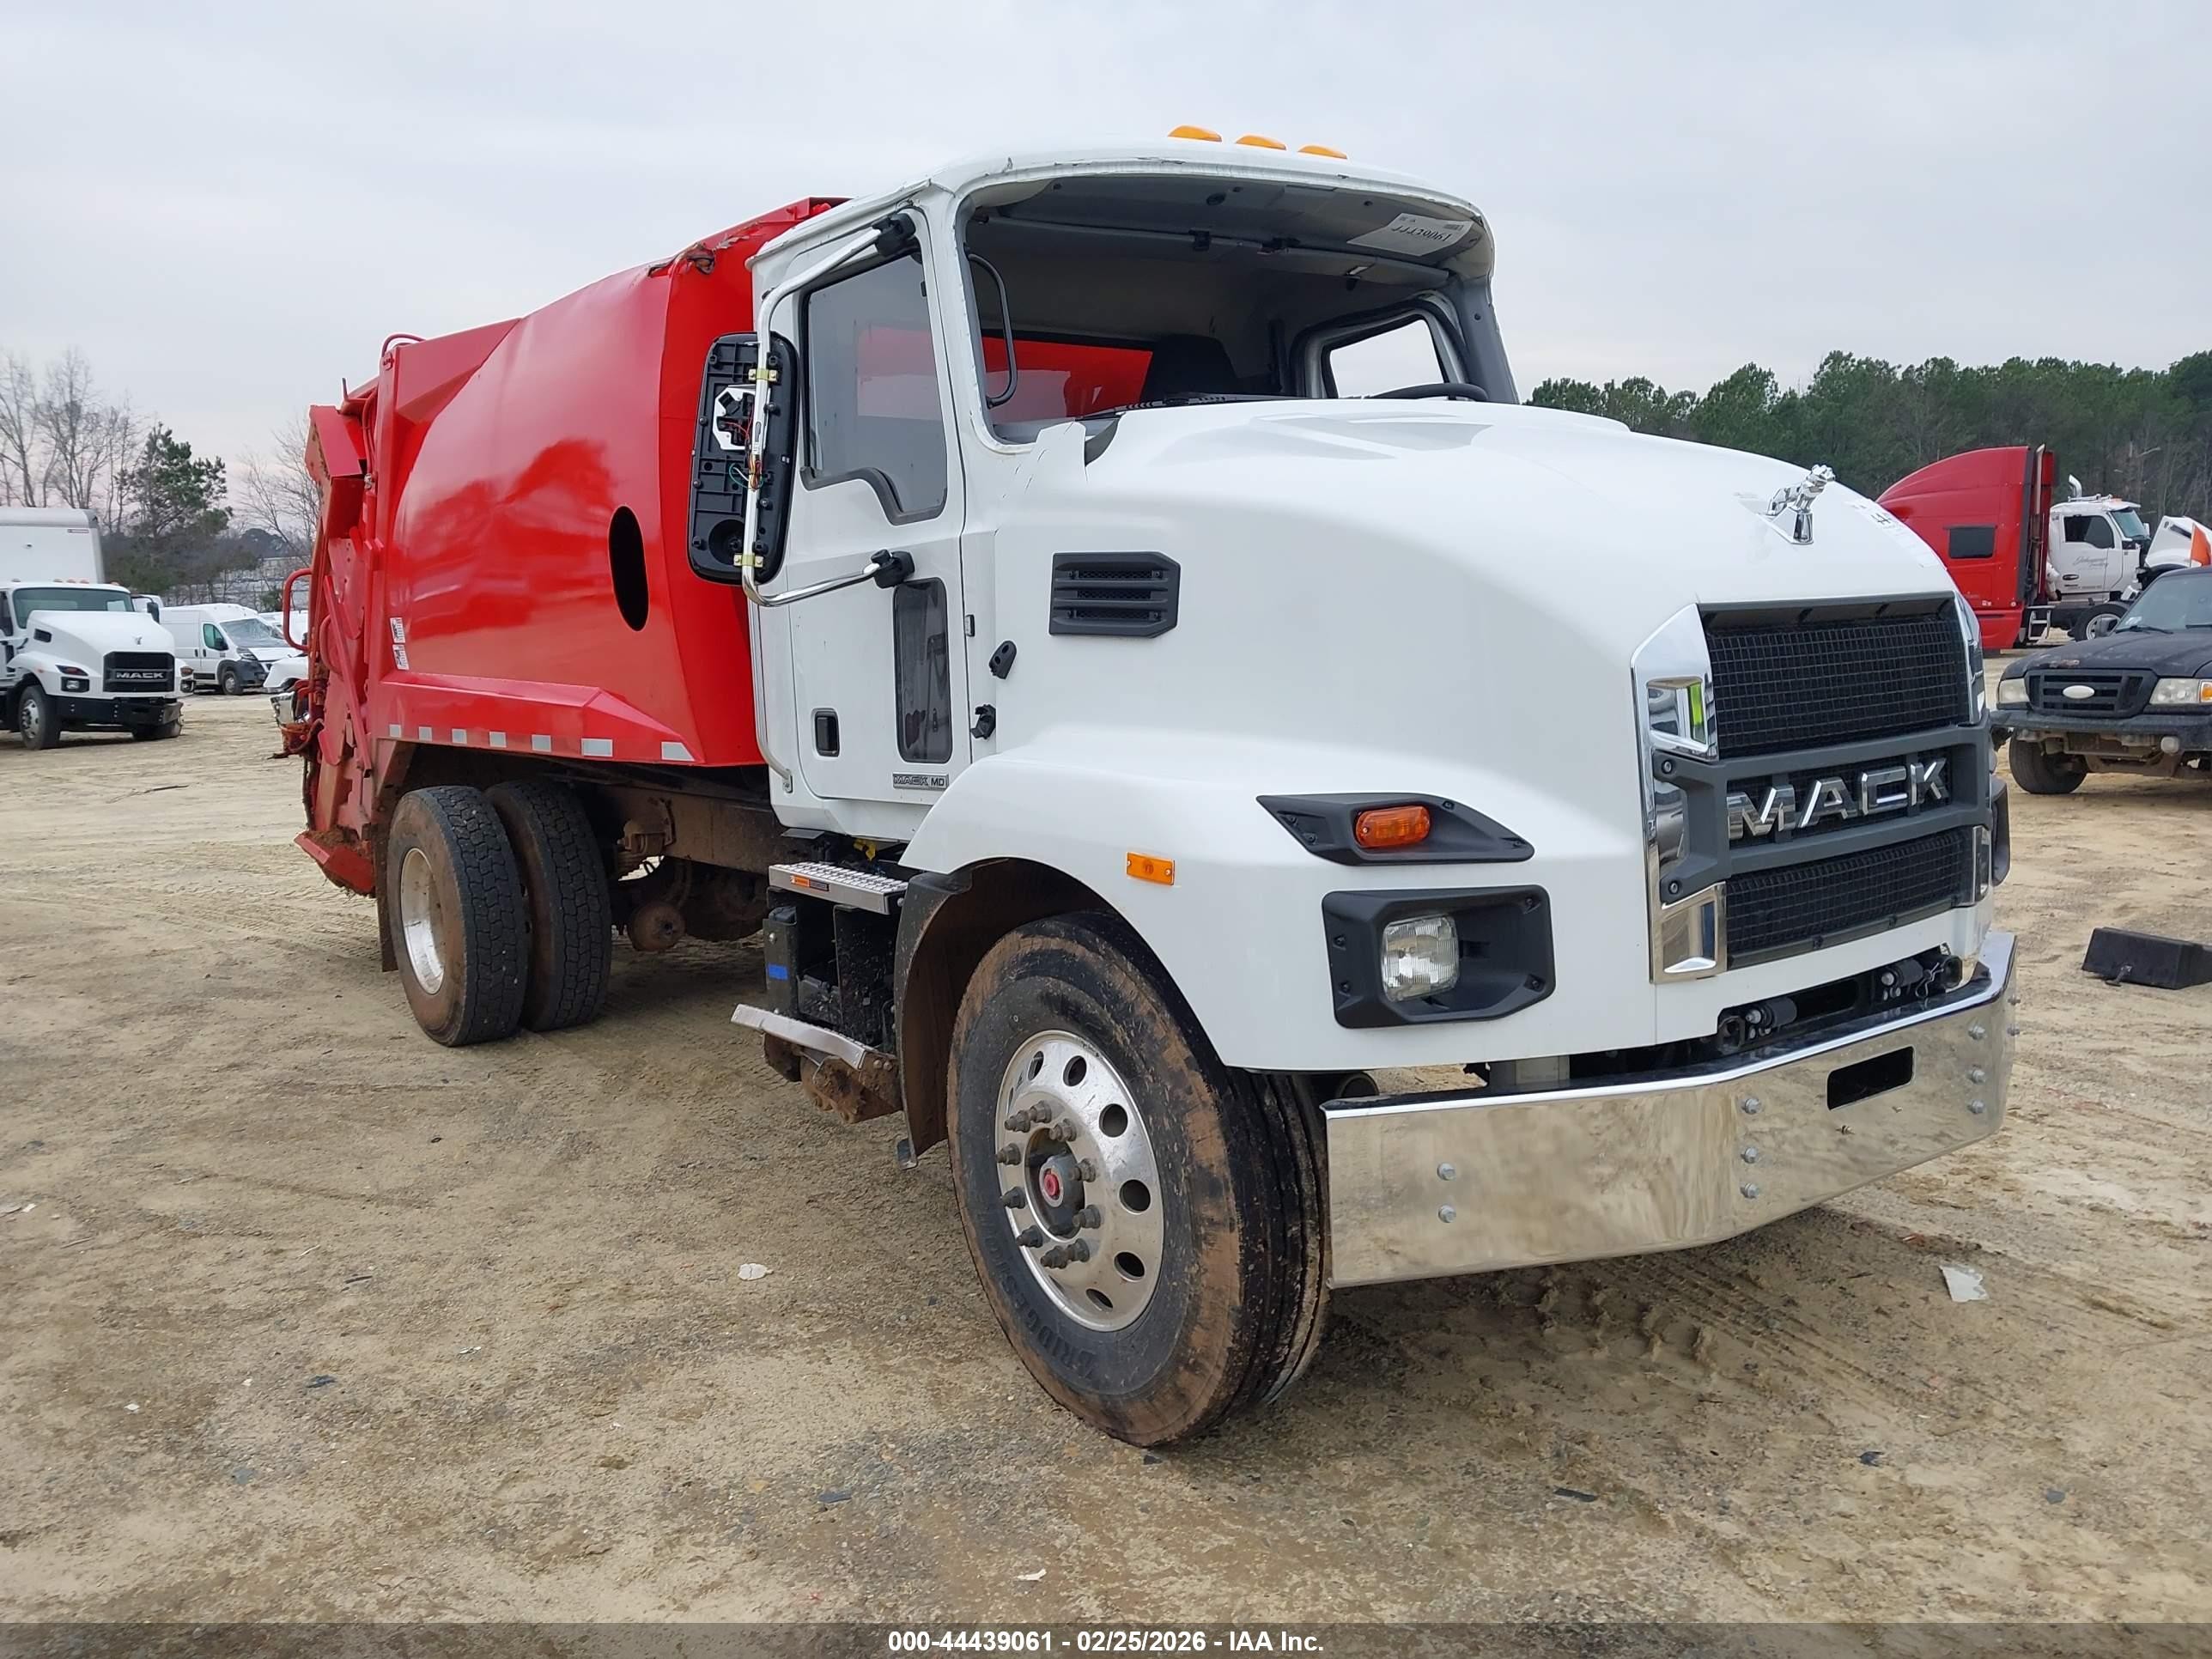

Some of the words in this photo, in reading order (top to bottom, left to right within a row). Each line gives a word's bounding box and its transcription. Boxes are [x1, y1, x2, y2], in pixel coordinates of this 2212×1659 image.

[894, 775, 928, 787] MACK
[931, 777, 945, 787] MD
[1726, 757, 1950, 840] MACK
